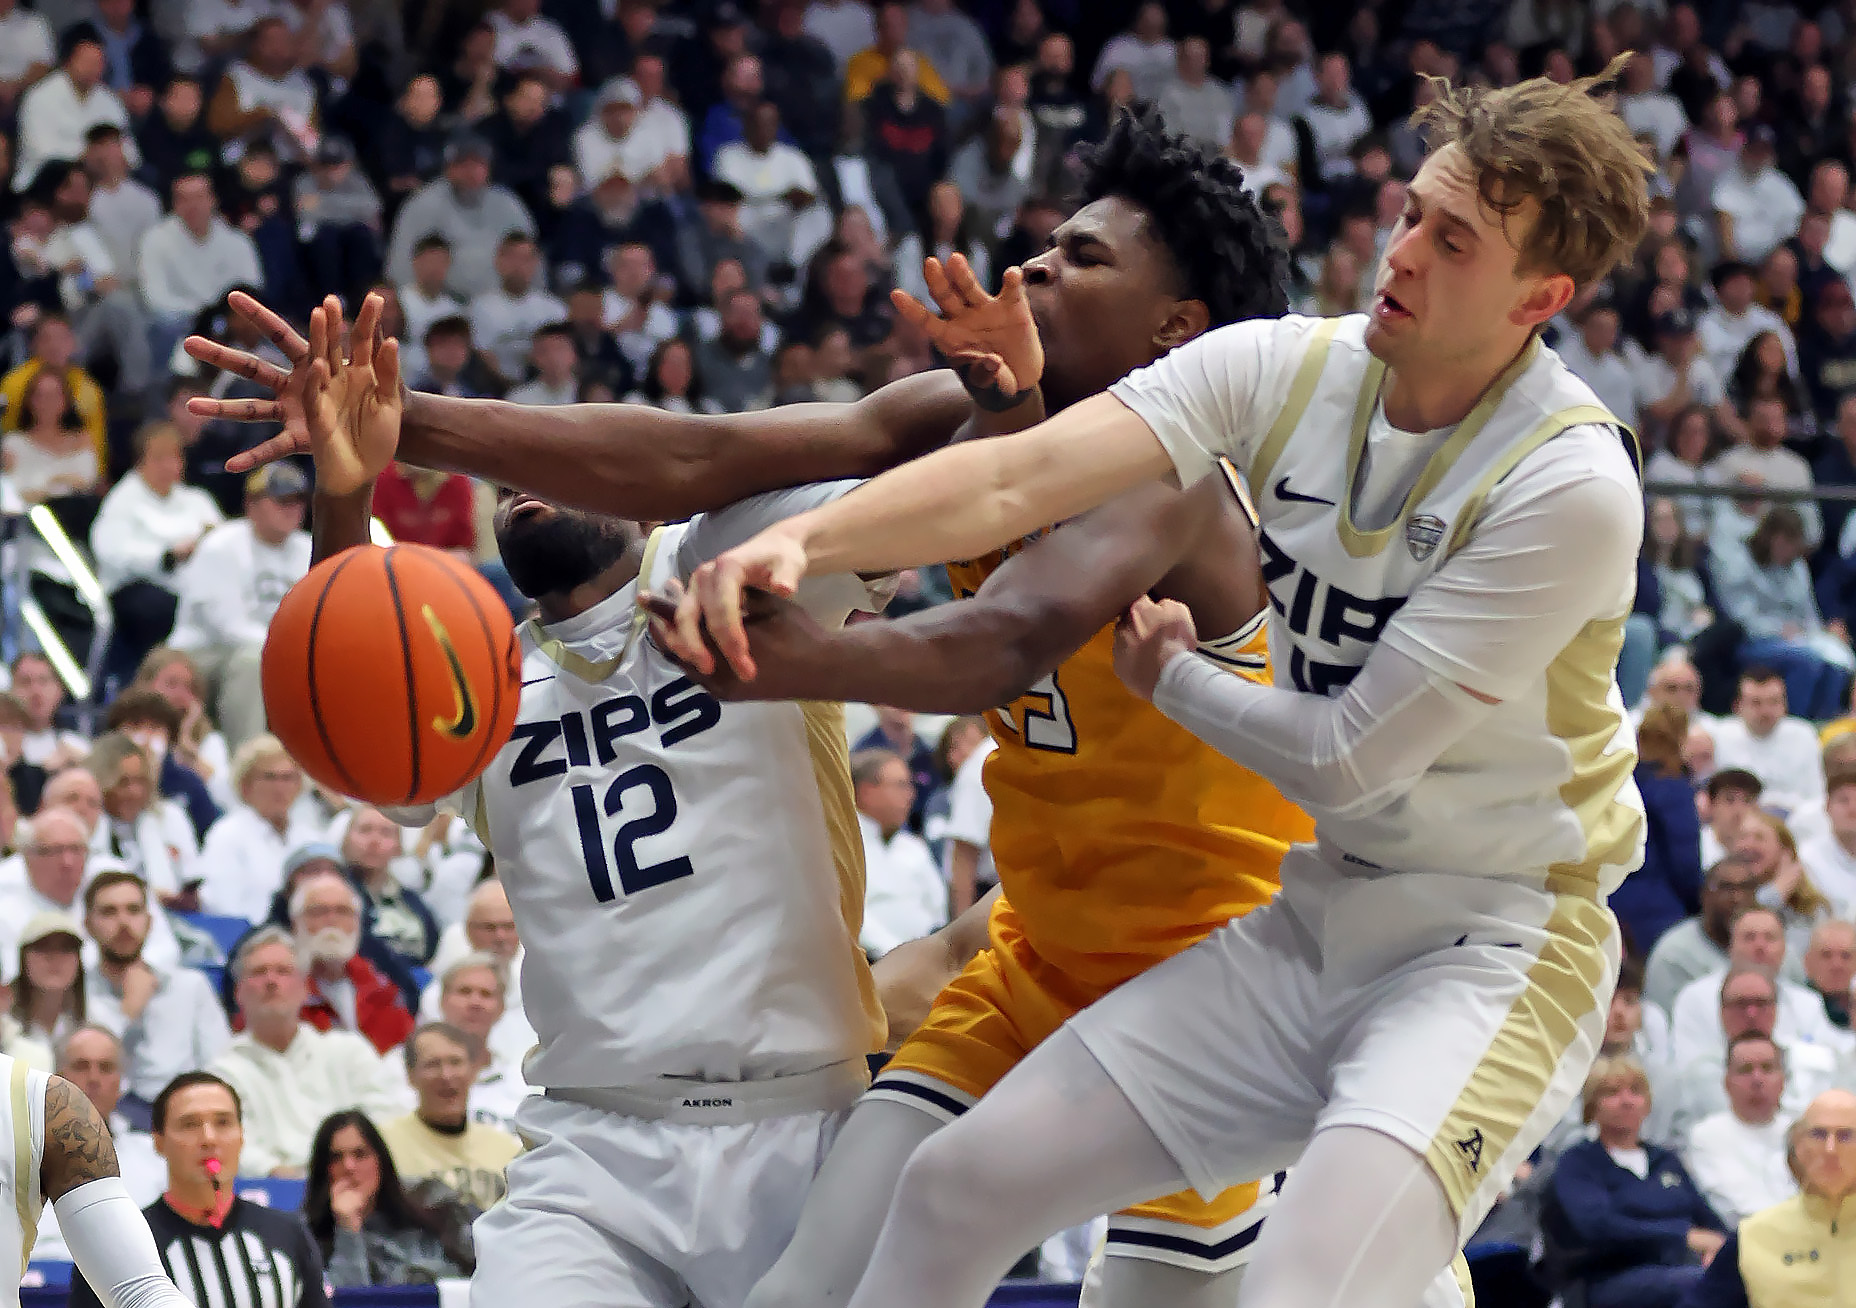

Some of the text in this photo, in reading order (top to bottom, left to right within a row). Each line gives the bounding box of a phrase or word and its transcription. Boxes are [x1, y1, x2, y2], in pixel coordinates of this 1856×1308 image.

[511, 675, 721, 787] ZIPS
[572, 764, 694, 903] 12
[682, 1098, 733, 1108] AKRON
